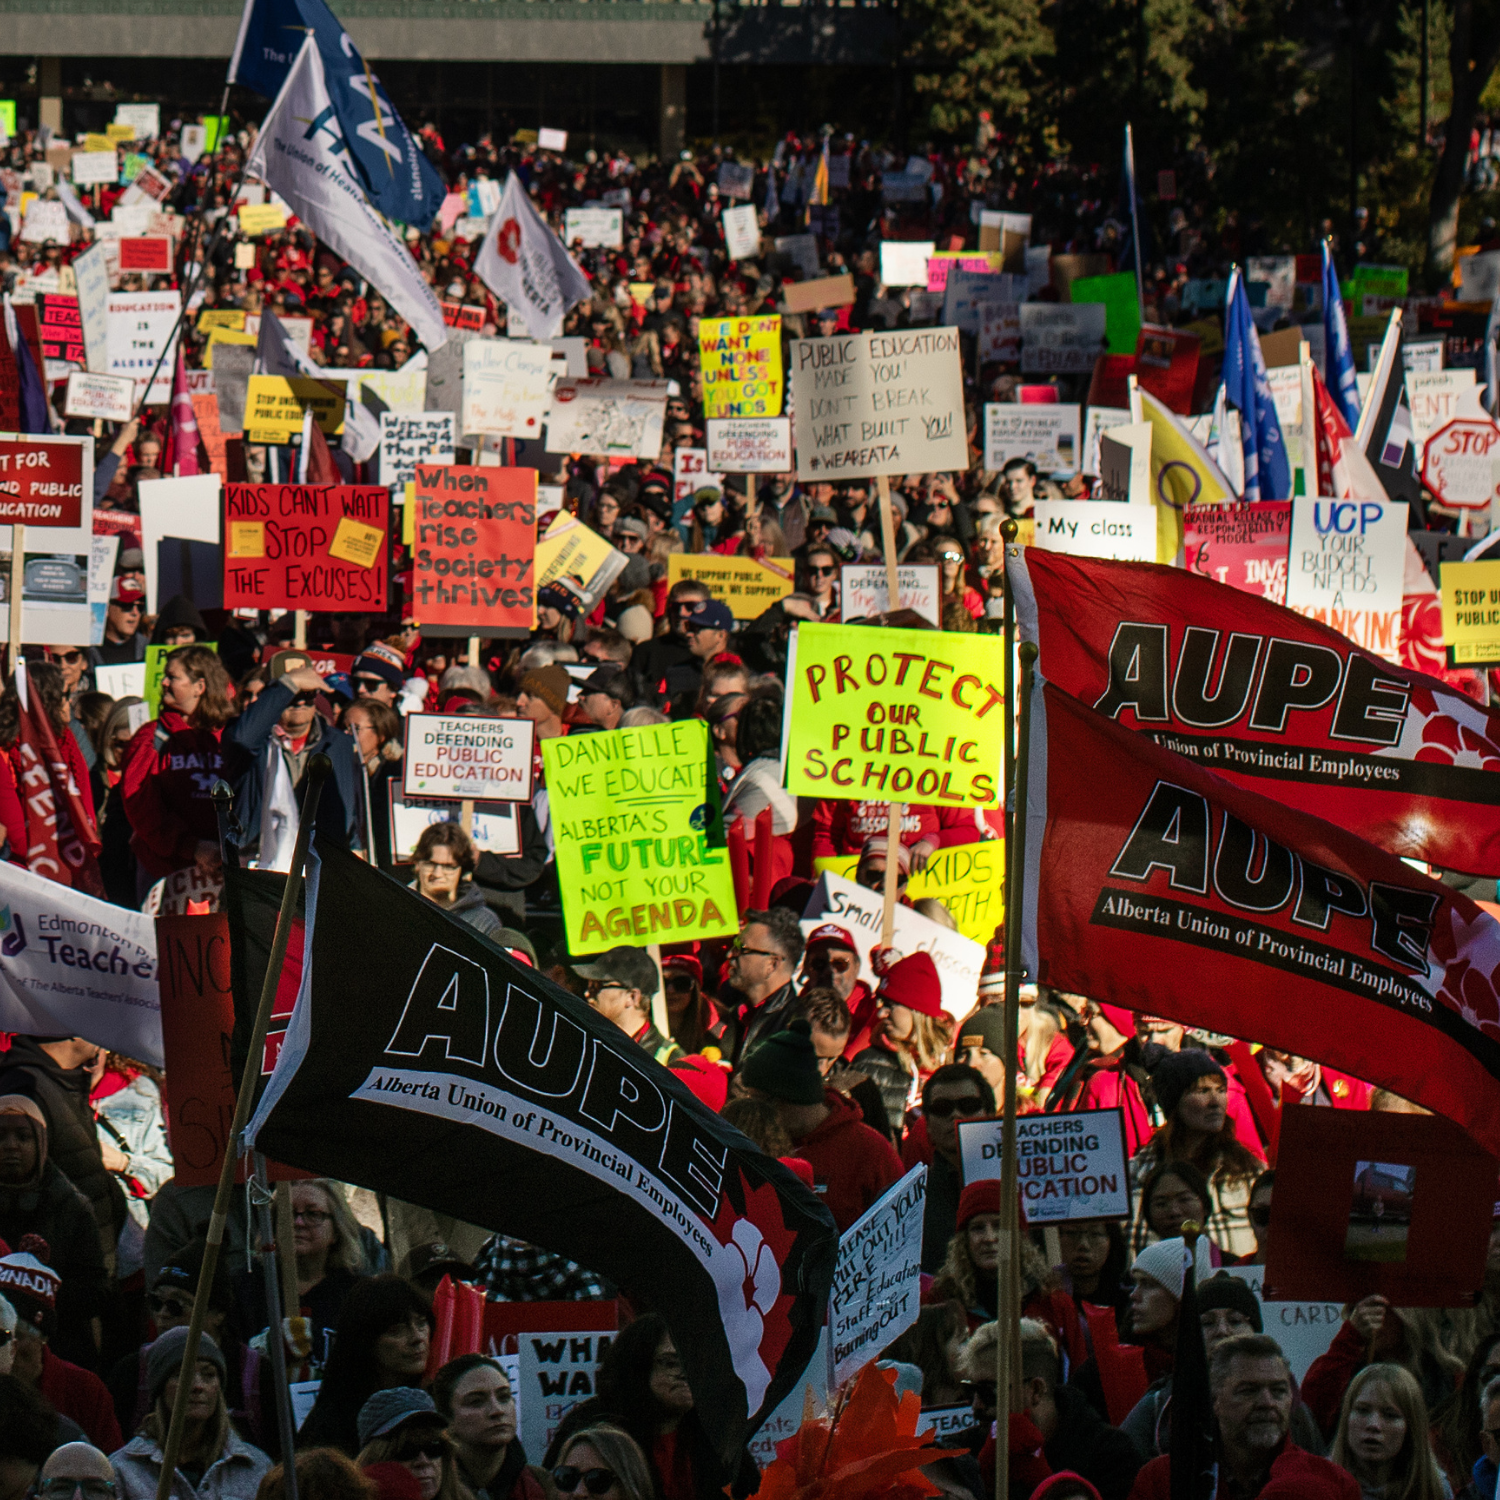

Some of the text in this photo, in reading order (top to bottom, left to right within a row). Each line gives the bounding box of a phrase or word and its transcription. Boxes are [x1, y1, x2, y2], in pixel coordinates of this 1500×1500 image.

[264, 48, 285, 62] The
[702, 335, 751, 353] WANT
[799, 333, 958, 371] PUBLIC EDUCATION
[721, 349, 771, 367] NONE
[705, 366, 769, 384] UNLESS
[256, 394, 276, 405] STOP
[706, 381, 778, 401] YOU GOT
[872, 388, 932, 412] BREAK
[254, 408, 283, 419] PUBLIC
[708, 400, 766, 418] FUNDS
[427, 417, 452, 429] not
[717, 428, 779, 439] DEFENDING
[813, 418, 910, 449] WHAT BUILT
[385, 430, 439, 445] asking
[385, 443, 414, 456] the
[726, 438, 772, 449] PUBLIC
[1444, 430, 1498, 456] STOP
[15, 451, 51, 470] FOR
[711, 450, 786, 461] EDUCATION
[29, 479, 82, 497] PUBLIC
[417, 468, 488, 493] When
[227, 485, 386, 519] KIDS CAN'T WAIT
[415, 495, 536, 526] Teachers
[1049, 516, 1133, 540] My class
[1197, 522, 1285, 535] RESPONSIBILITY
[1233, 512, 1274, 523] RELEASE
[1313, 501, 1384, 534] UCP
[264, 520, 328, 560] STOP
[419, 522, 478, 549] rise
[1215, 533, 1256, 544] MODEL
[1317, 533, 1366, 554] YOUR
[417, 549, 534, 582] Society
[1301, 550, 1374, 574] BUDGET
[228, 568, 270, 596] THE
[696, 569, 764, 583] SUPPORT PUBLIC
[1314, 573, 1378, 594] NEEDS
[415, 579, 534, 609] thrives
[744, 585, 781, 597] SUPPORT
[1455, 589, 1488, 606] STOP
[1456, 610, 1500, 626] PUBLIC
[805, 651, 1005, 719] PROTECT
[1093, 620, 1415, 747] AUPE
[866, 701, 923, 728] OUR
[438, 720, 505, 735] TEACHERS
[424, 733, 514, 749] DEFENDING
[555, 726, 689, 768] DANIELLE
[832, 724, 980, 764] PUBLIC
[436, 747, 504, 764] PUBLIC
[1223, 741, 1401, 782] Provincial Employees
[413, 763, 523, 782] EDUCATION
[556, 761, 713, 799] WE EDUCATE
[803, 747, 997, 804] SCHOOLS
[559, 810, 669, 844] ALBERTA'S
[580, 835, 725, 876] FUTURE
[925, 849, 992, 888] KIDS
[1109, 780, 1441, 977] AUPE
[581, 870, 710, 904] NOT YOUR
[38, 913, 132, 949] Edmonton
[579, 899, 726, 942] AGENDA
[1101, 894, 1434, 1014] Alberta Union of Provincial Employees
[50, 981, 86, 997] Alberta
[384, 942, 730, 1221] AUPE
[366, 1075, 715, 1259] Alberta Union of Provincial Employees
[891, 1174, 928, 1226] YOUR
[832, 1255, 878, 1316] FIRE
